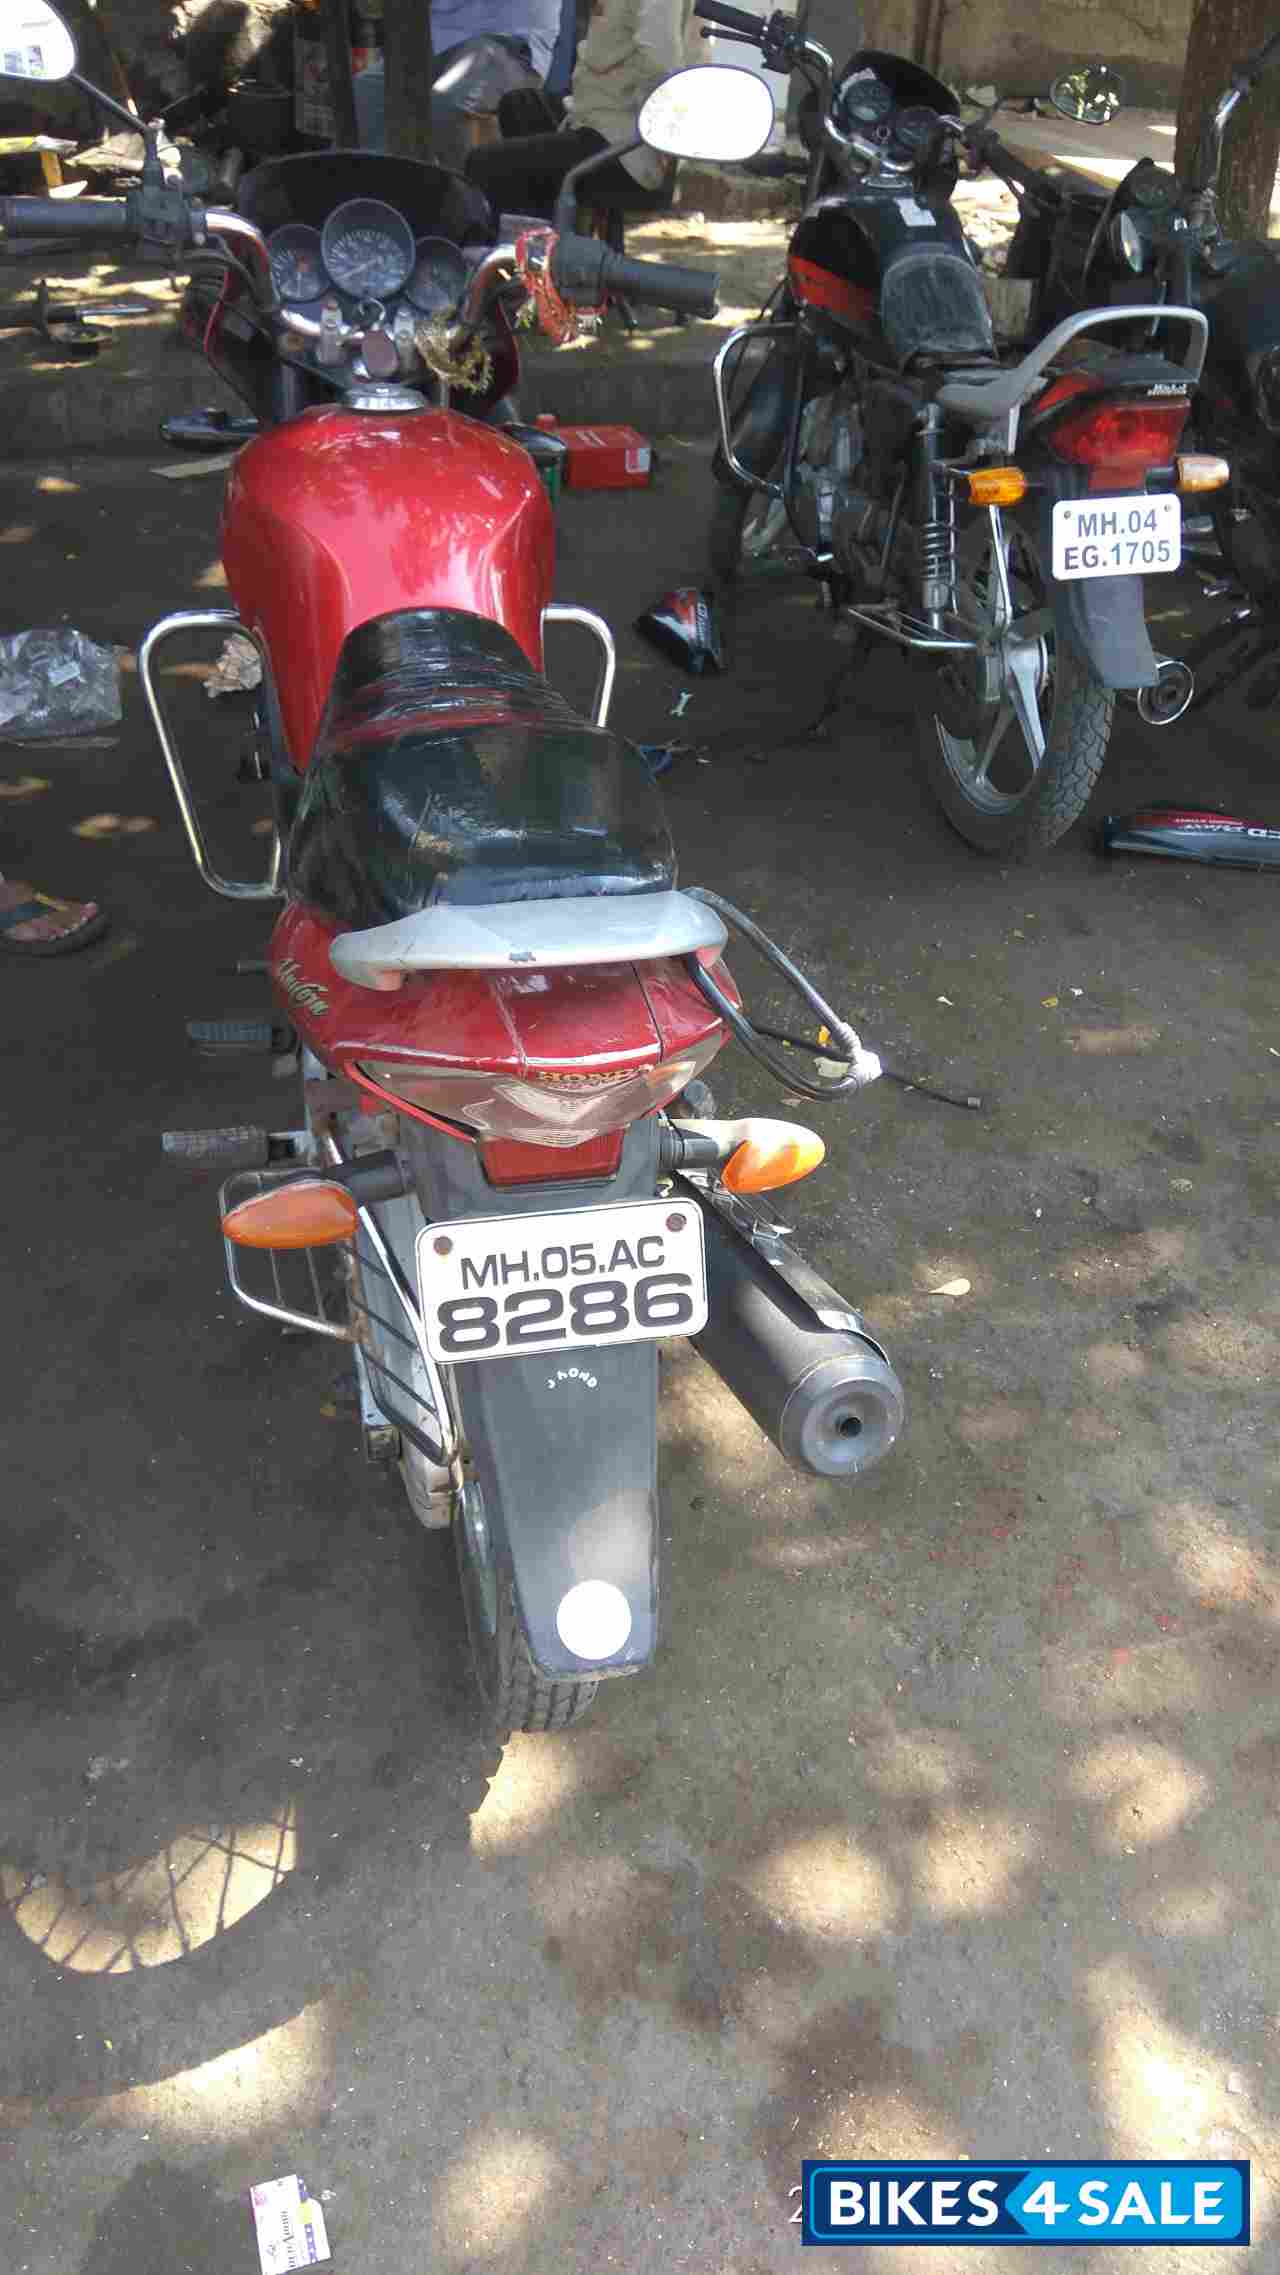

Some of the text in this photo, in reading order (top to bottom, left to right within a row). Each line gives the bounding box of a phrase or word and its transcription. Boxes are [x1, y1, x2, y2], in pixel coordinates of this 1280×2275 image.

[1077, 509, 1158, 538] MH.04
[1064, 540, 1171, 570] EG.1705
[460, 1235, 665, 1290] MH.05.AC
[437, 1273, 693, 1353] 8286
